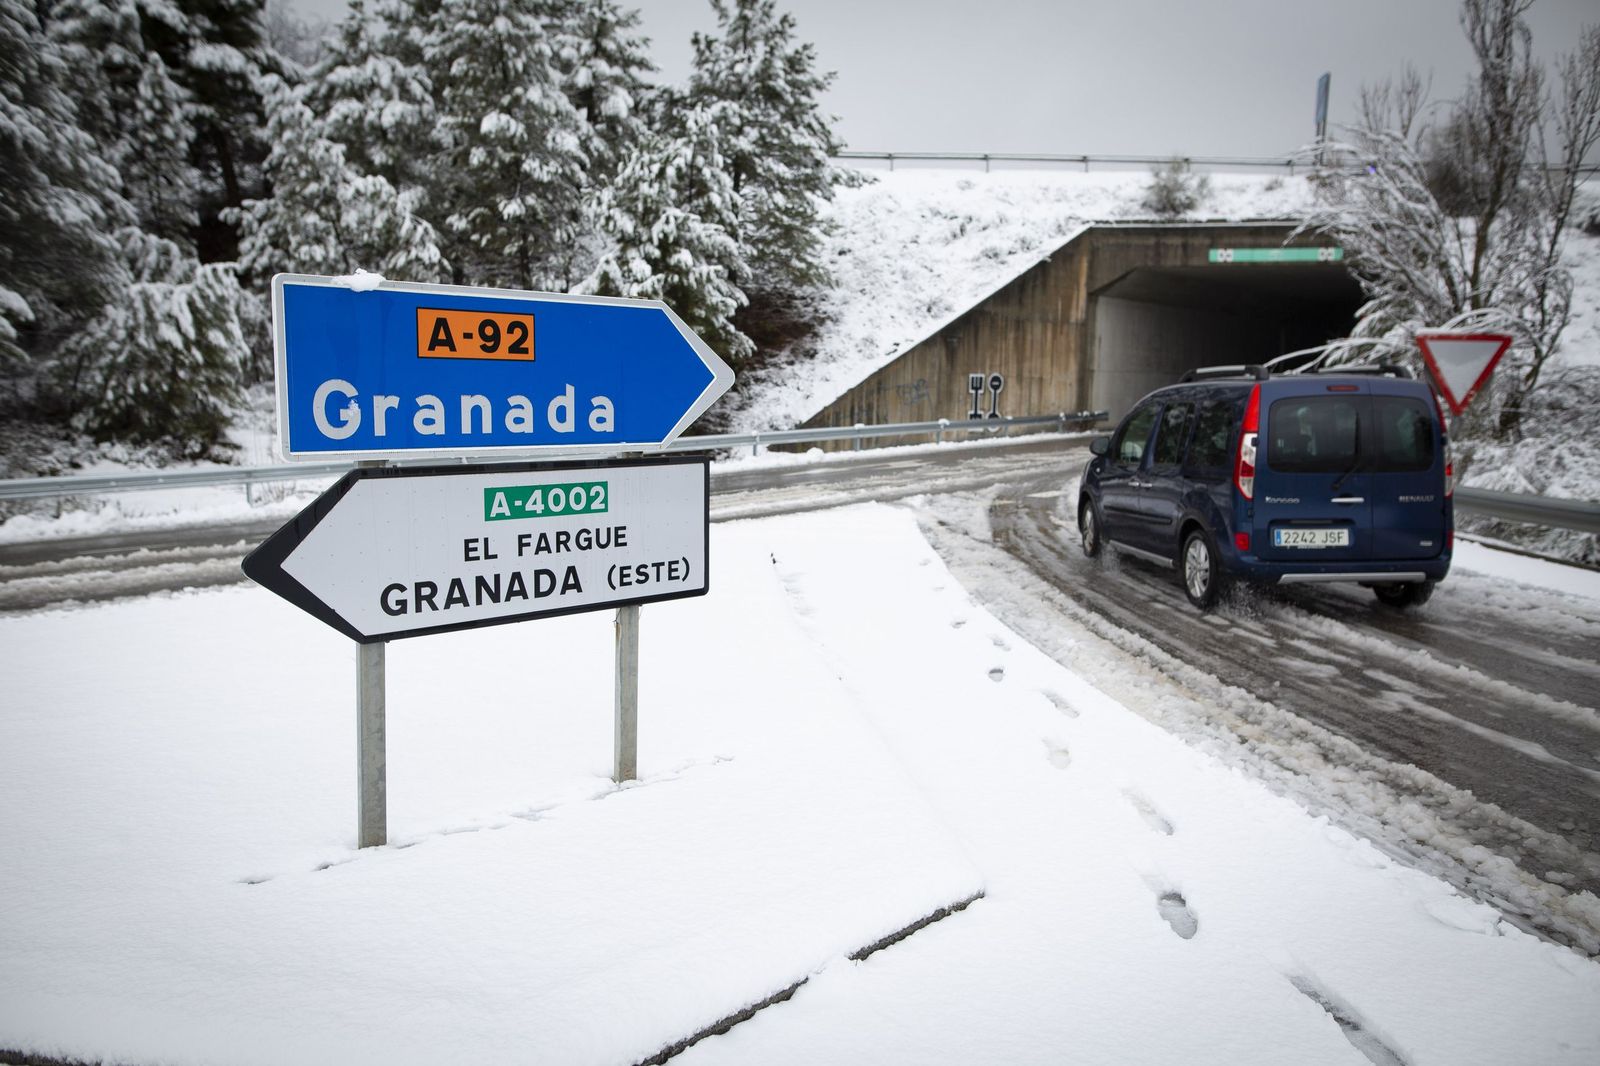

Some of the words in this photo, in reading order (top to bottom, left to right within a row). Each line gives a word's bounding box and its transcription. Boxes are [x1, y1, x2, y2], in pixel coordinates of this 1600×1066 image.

[427, 317, 530, 355] A-92
[312, 378, 616, 440] Granada
[489, 485, 607, 518] A-4002
[464, 537, 498, 562] EL
[517, 525, 628, 556] FARGUE
[1284, 531, 1316, 544] 2242
[1321, 531, 1345, 544] JSF
[380, 565, 583, 617] GRANADA
[607, 556, 690, 591] (ESTE)
